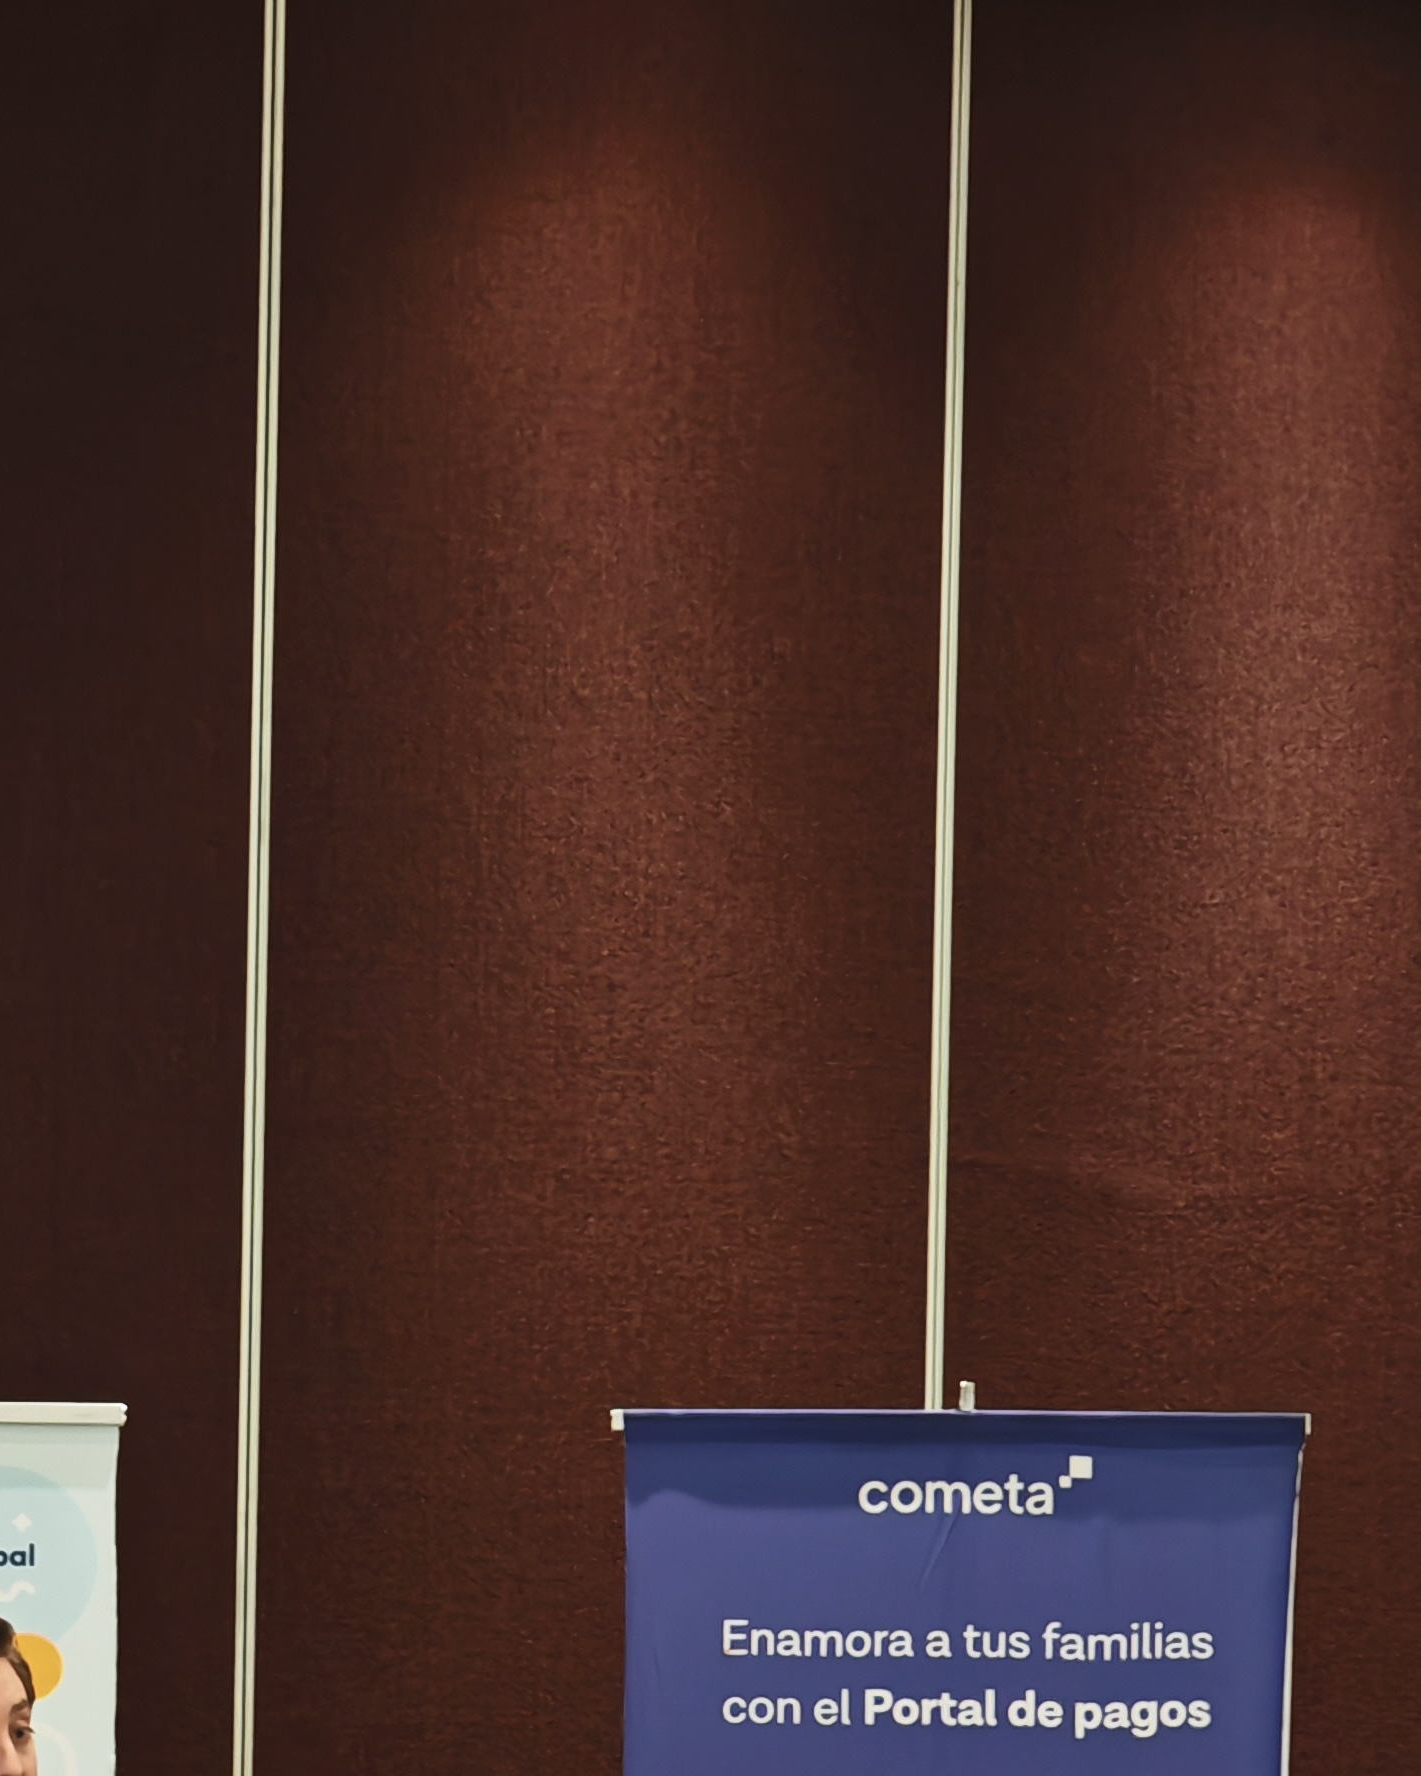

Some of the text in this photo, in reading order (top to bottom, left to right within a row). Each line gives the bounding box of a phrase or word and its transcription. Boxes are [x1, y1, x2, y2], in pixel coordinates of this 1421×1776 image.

[858, 1475, 1054, 1516] cometa
[722, 1619, 1215, 1662] Enamora a tus familias
[722, 1689, 1212, 1739] con el Portal de pagos
